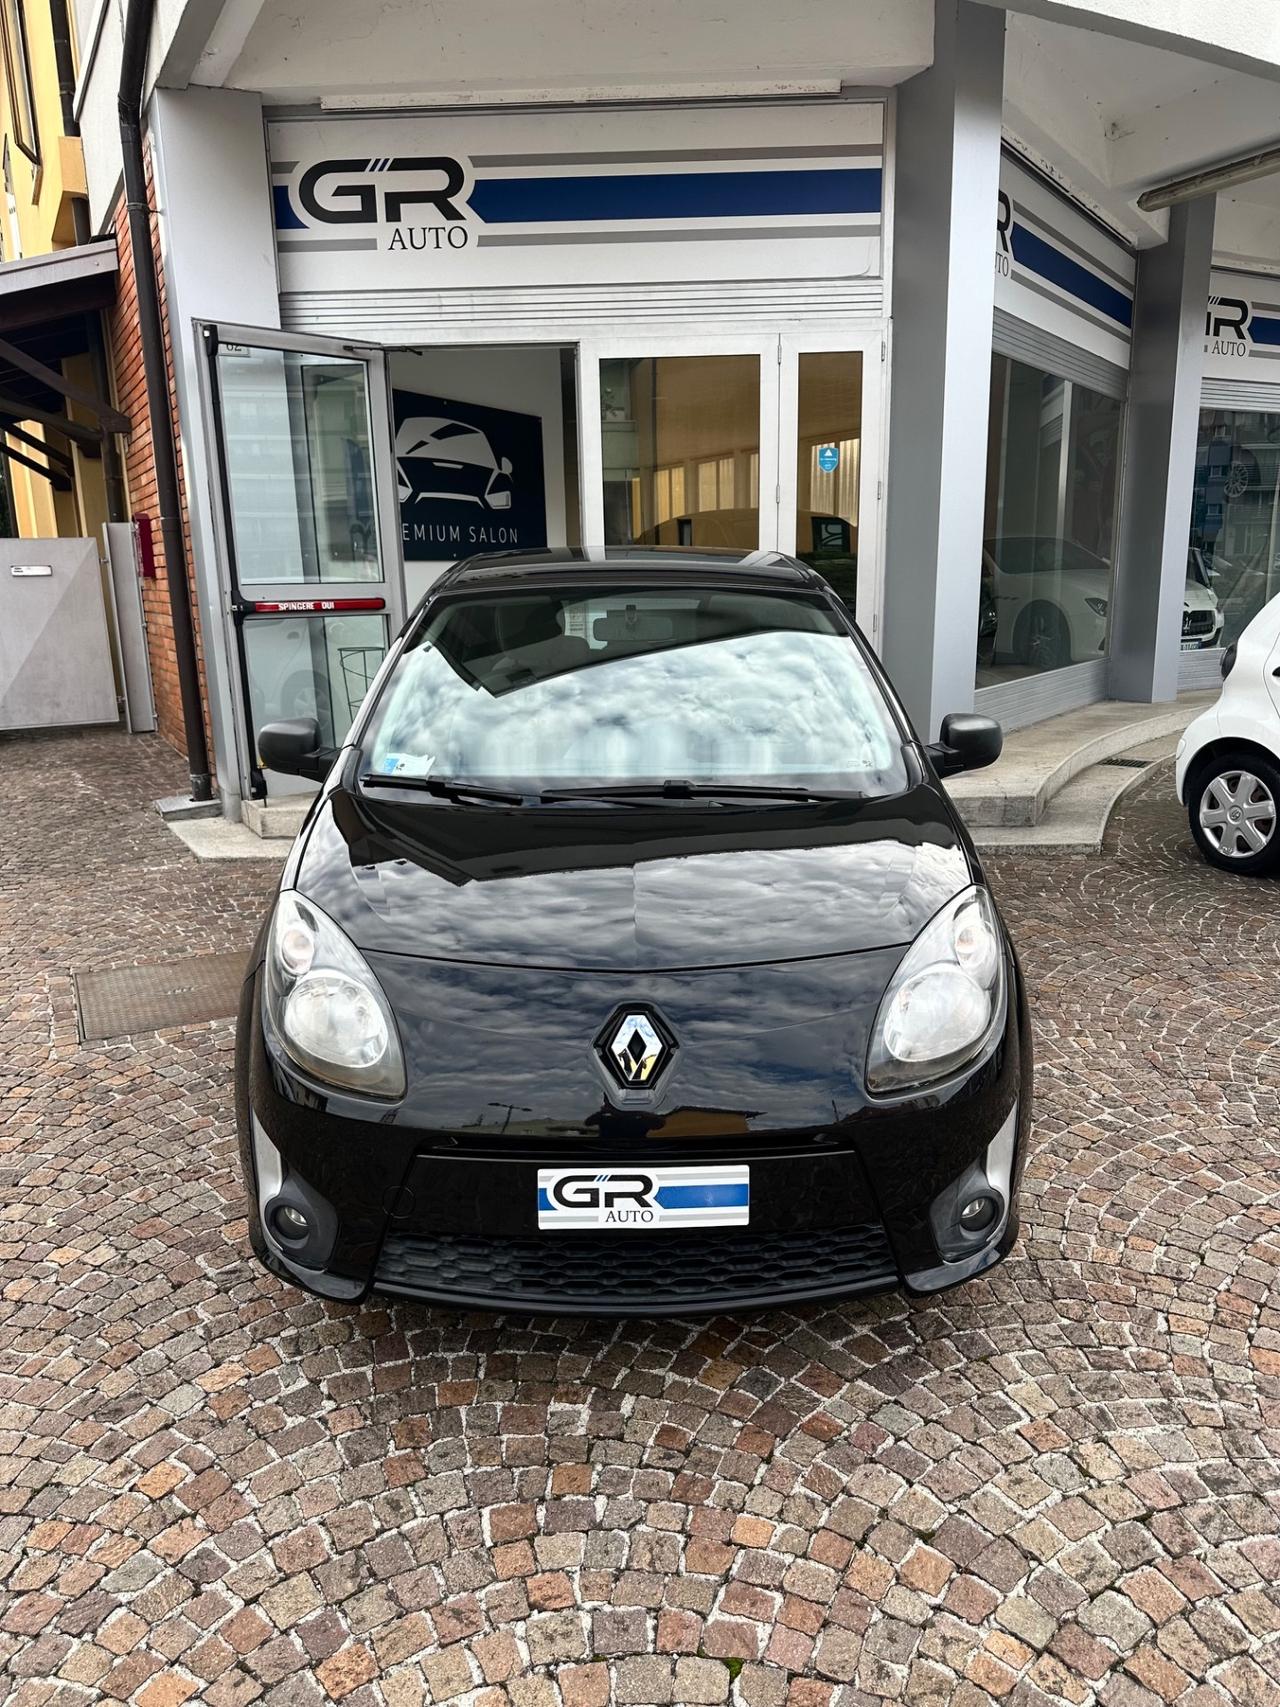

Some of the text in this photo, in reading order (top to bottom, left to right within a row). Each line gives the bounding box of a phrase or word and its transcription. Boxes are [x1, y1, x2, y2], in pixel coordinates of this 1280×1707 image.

[298, 156, 467, 225] GR
[387, 225, 469, 251] AUTO
[1205, 295, 1249, 340] R
[1211, 340, 1247, 357] AUTO
[402, 523, 519, 544] EMIUM SALON
[553, 1174, 654, 1209] GR
[605, 1210, 654, 1224] AUTO
